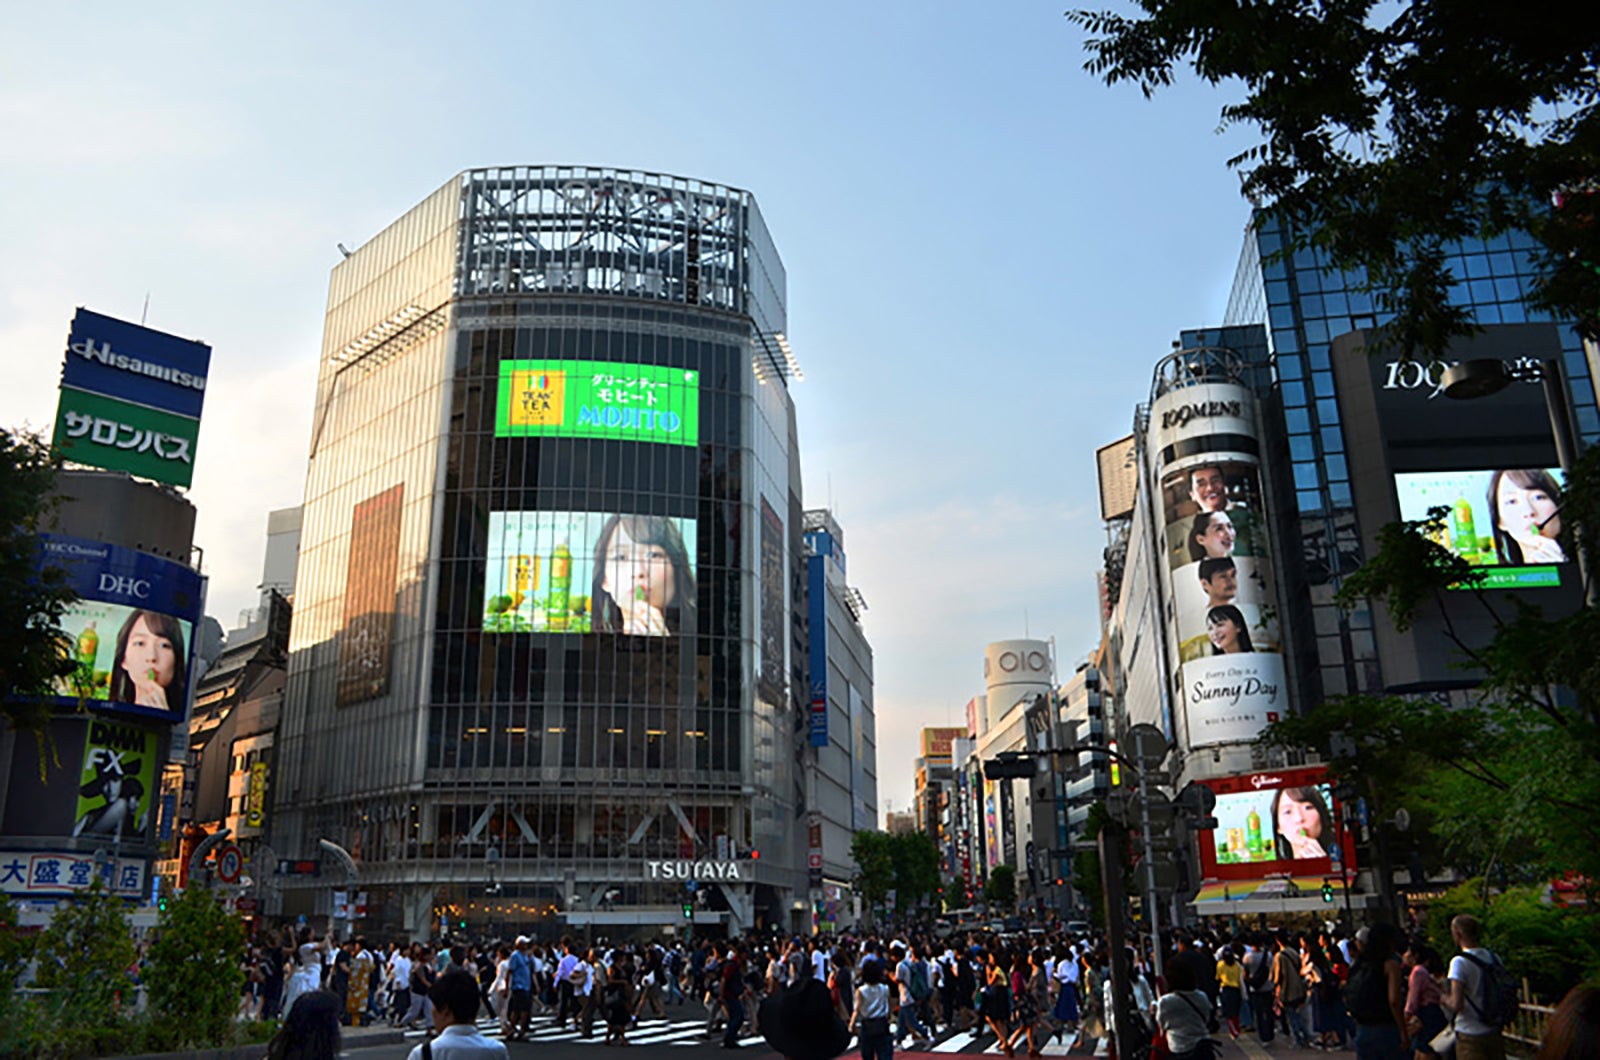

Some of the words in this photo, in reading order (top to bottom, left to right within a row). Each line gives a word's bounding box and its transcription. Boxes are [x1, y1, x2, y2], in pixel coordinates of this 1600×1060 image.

[70, 338, 206, 391] Hisamitsu
[591, 373, 669, 390] グリーンティー
[521, 399, 551, 411] TEA
[597, 388, 658, 406] モヒート
[578, 404, 681, 432] MOJITO
[64, 410, 191, 464] サロンパス
[98, 572, 150, 599] DHC
[1191, 681, 1242, 707] Sunny
[1243, 677, 1278, 705] Day
[91, 722, 145, 752] DMM
[85, 747, 125, 775] FX
[649, 860, 740, 879] TSUTAYA
